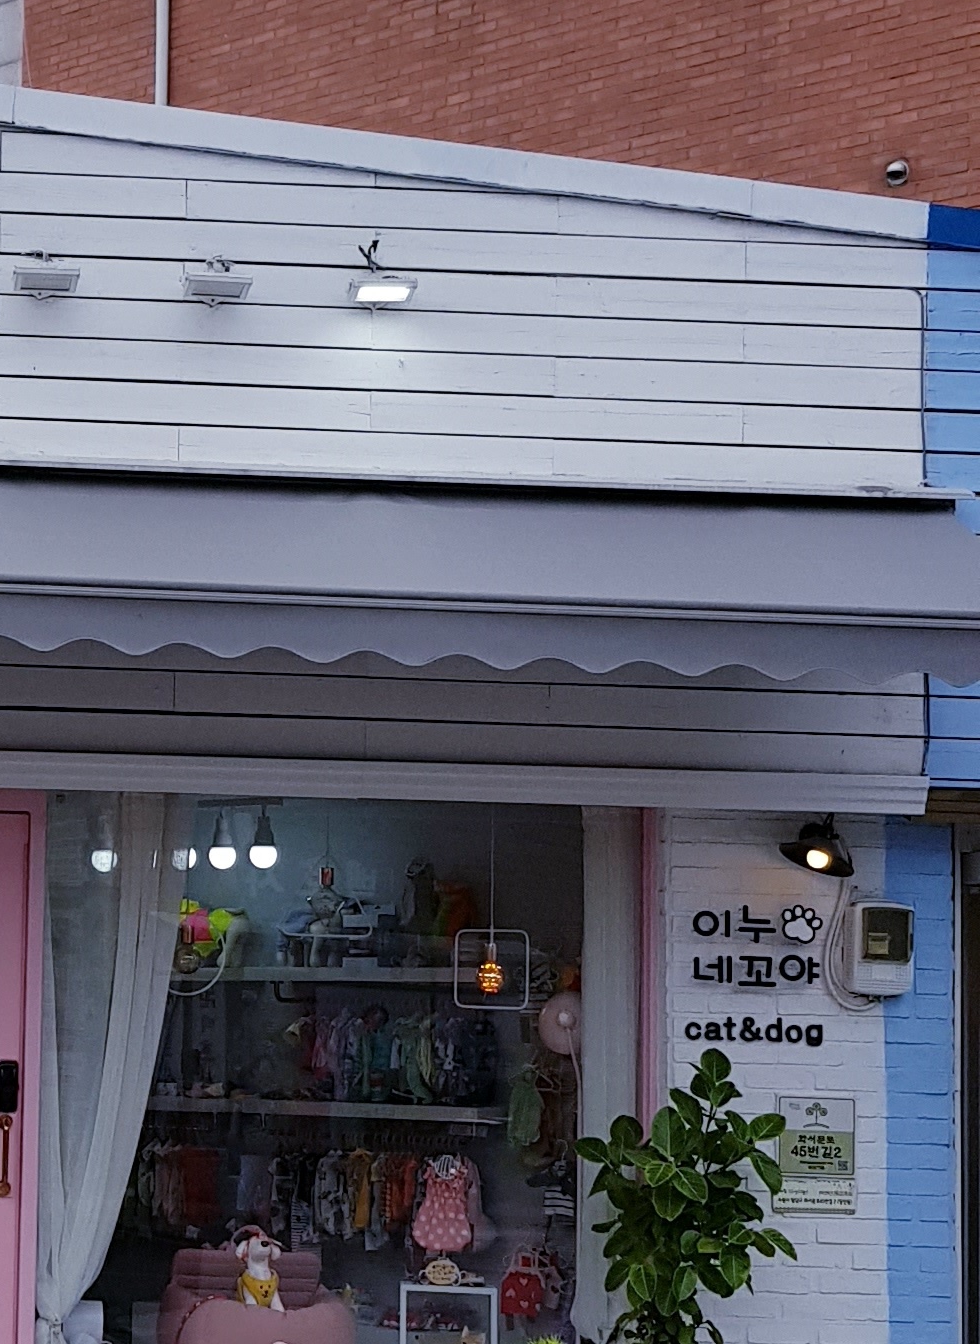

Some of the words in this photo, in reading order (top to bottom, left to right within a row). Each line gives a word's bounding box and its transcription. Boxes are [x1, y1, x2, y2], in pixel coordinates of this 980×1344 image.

[692, 905, 777, 943] 이누
[692, 955, 820, 987] 네꼬야
[684, 1017, 824, 1047] cat&dog
